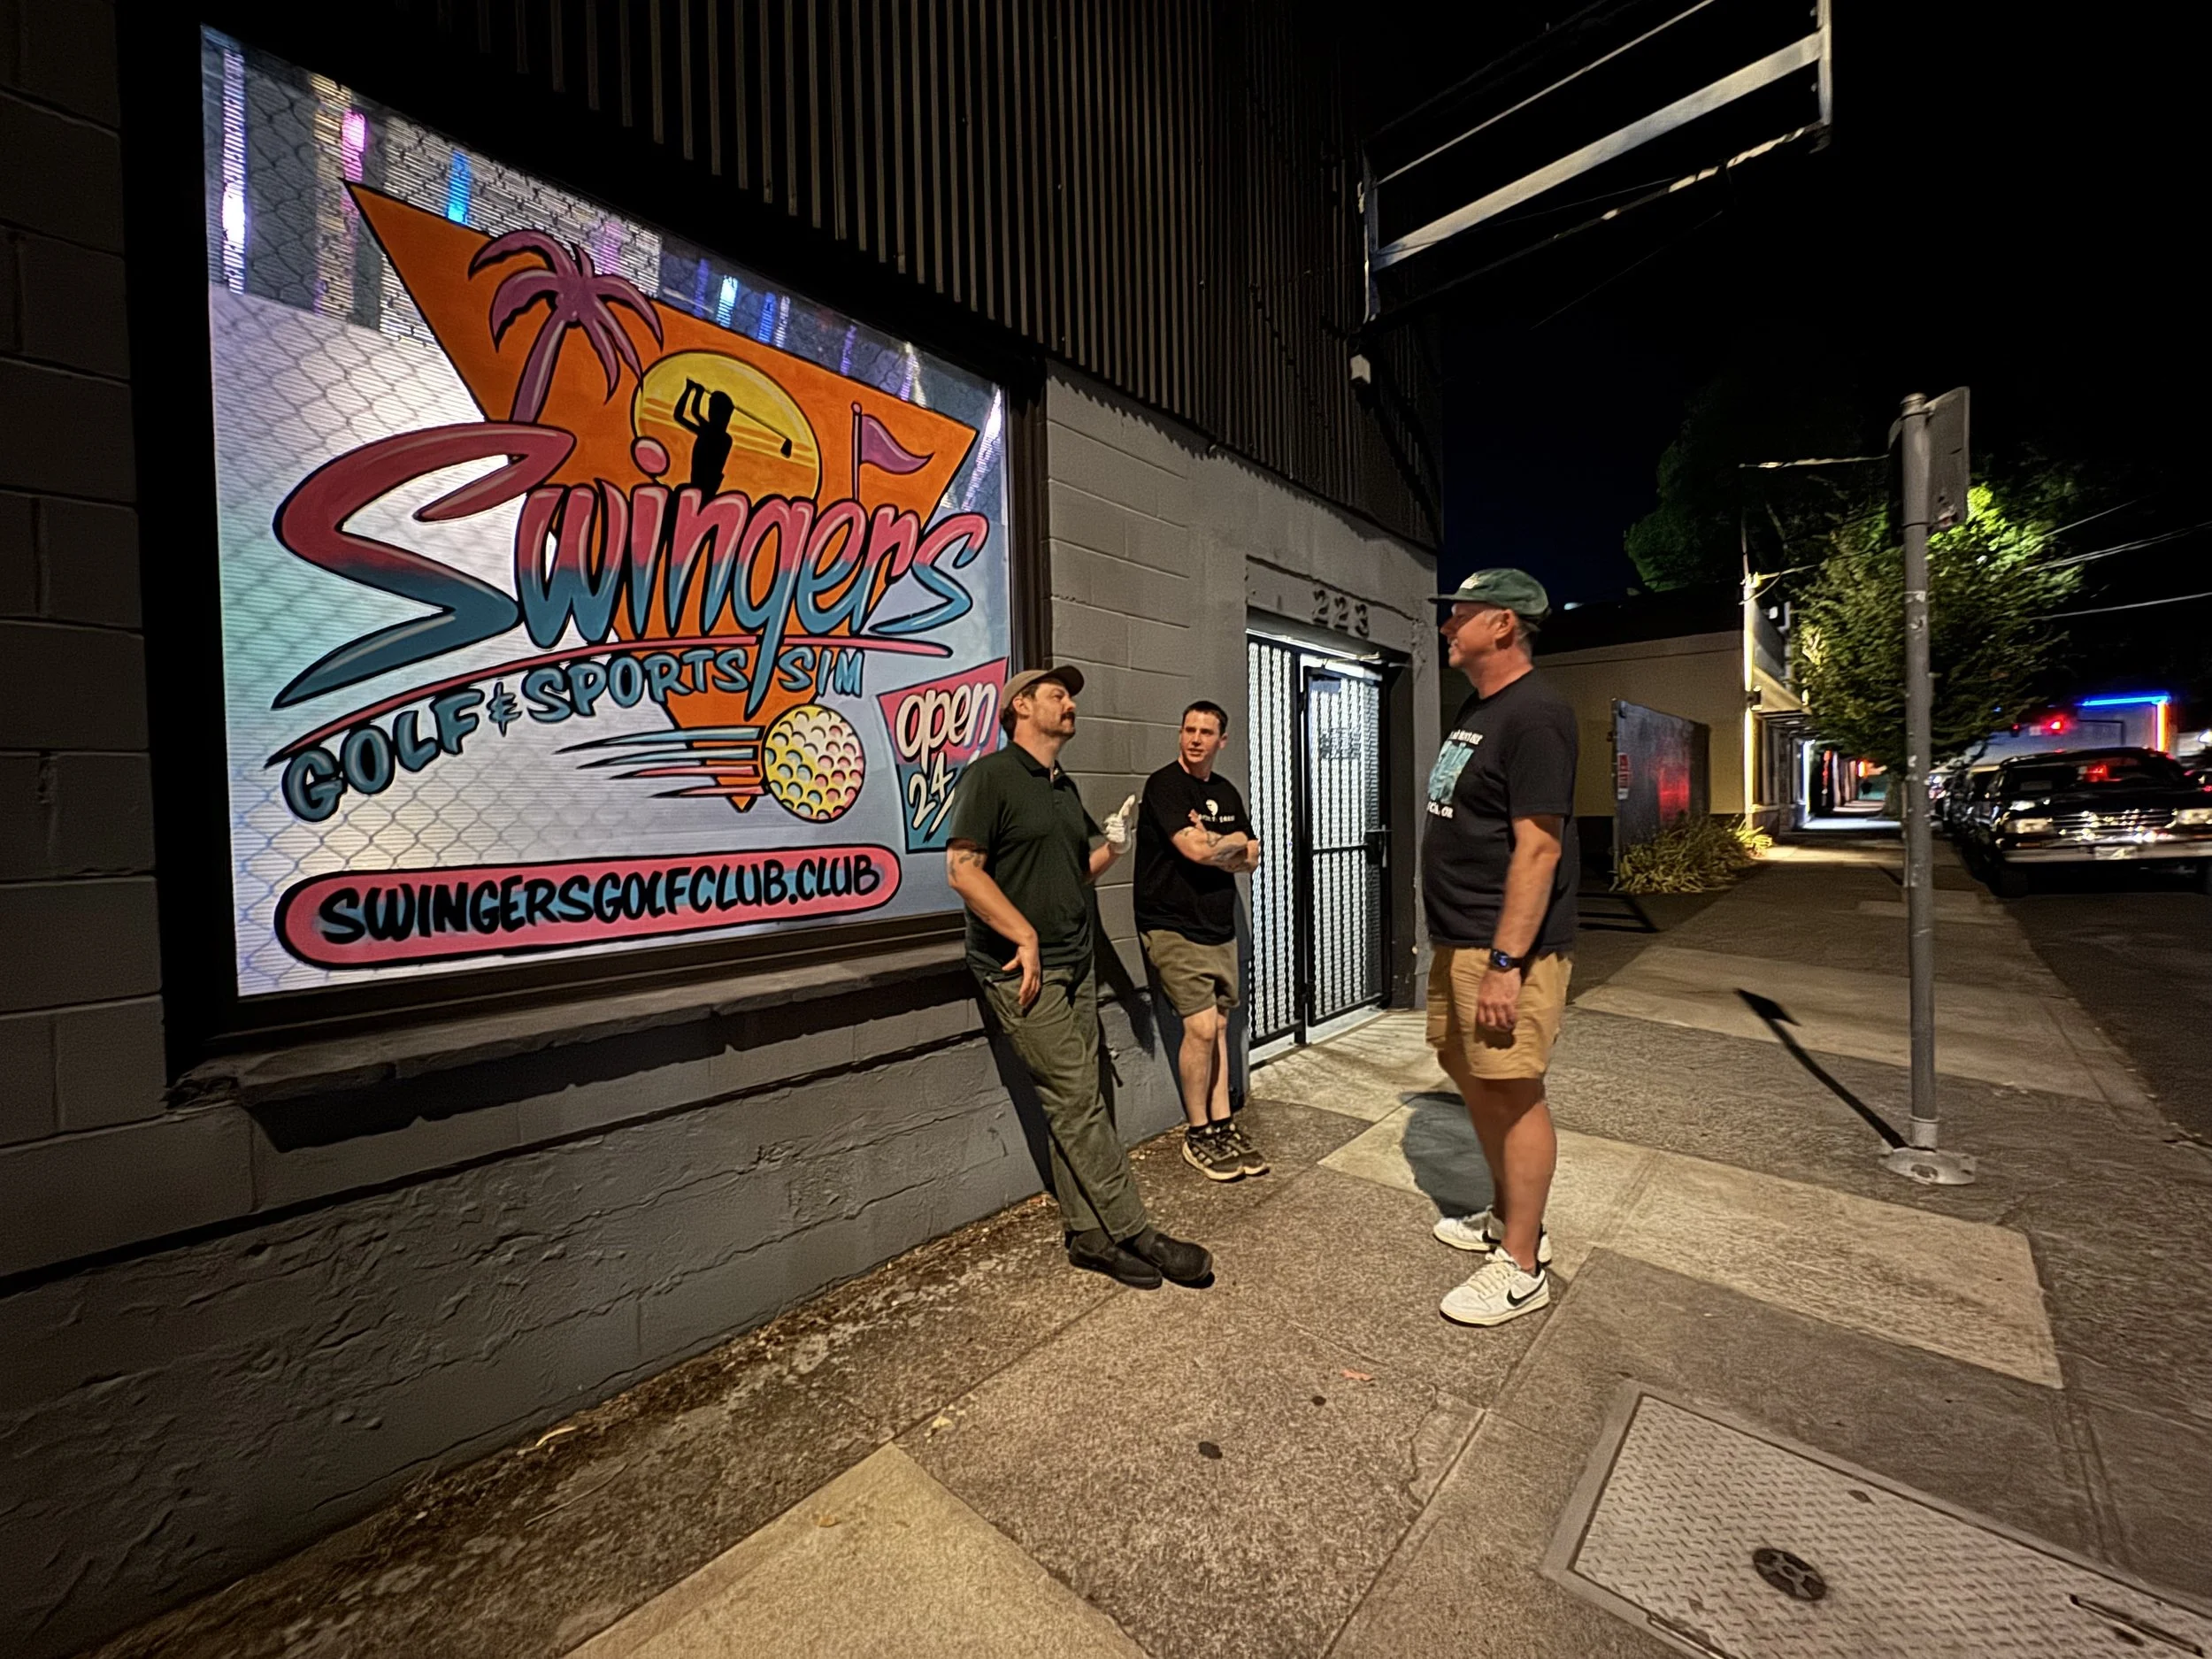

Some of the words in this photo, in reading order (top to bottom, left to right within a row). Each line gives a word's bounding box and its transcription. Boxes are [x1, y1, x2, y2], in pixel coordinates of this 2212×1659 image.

[272, 421, 989, 720] Swingers
[1311, 588, 1369, 639] 223
[281, 688, 485, 822] GOLF
[486, 680, 523, 737] &
[522, 645, 749, 722] SPORTS
[778, 646, 865, 698] SIM
[895, 681, 998, 776] open
[908, 750, 980, 841] 24/
[319, 854, 880, 944] SWINGERSGOLFCLUB.CLUB
